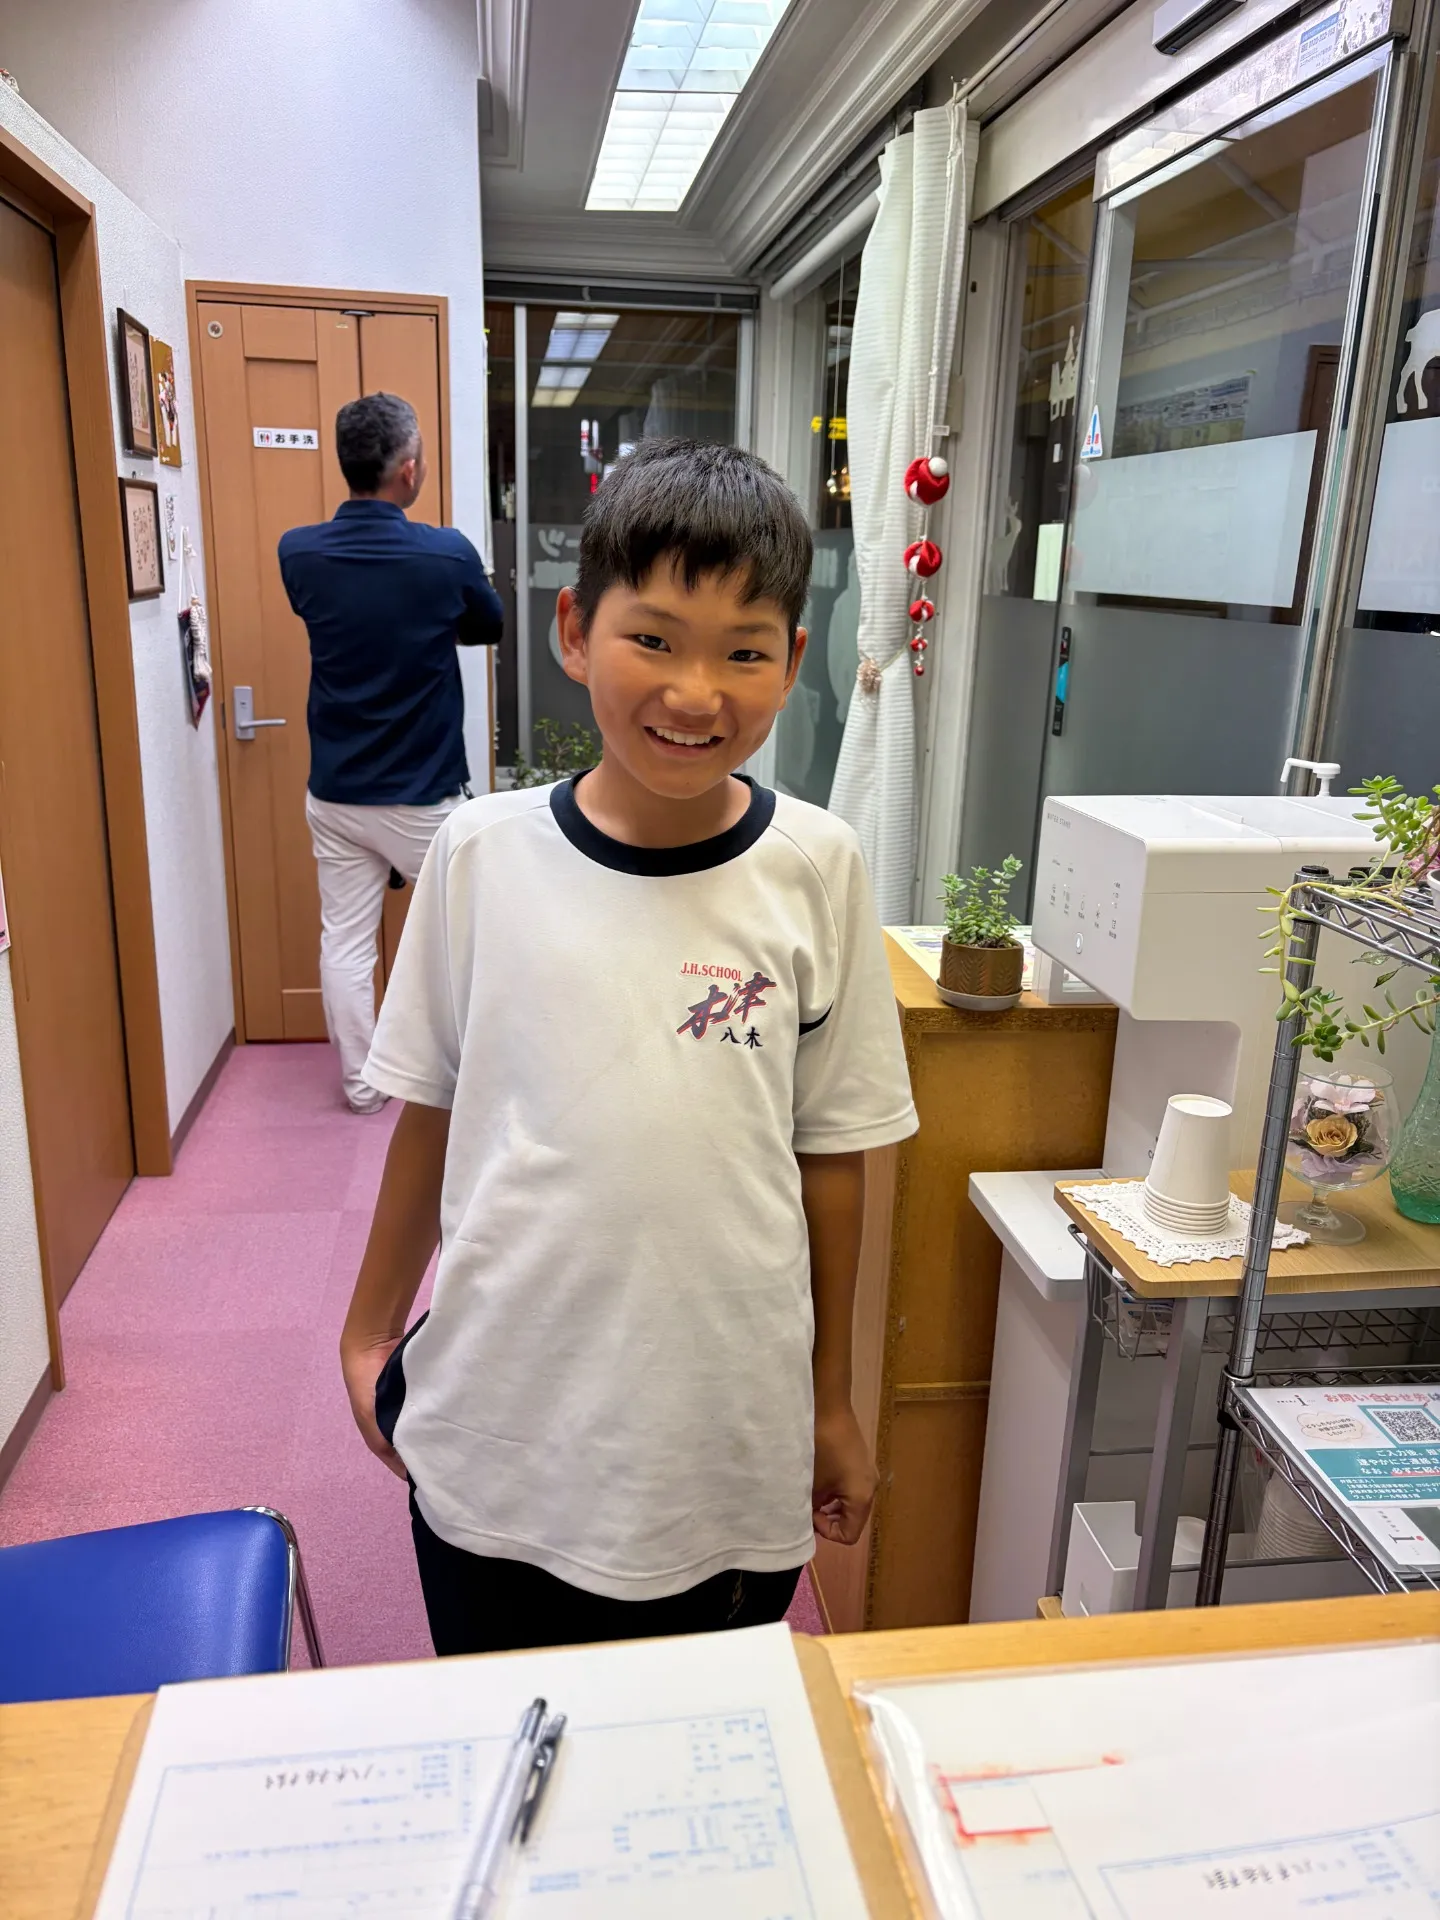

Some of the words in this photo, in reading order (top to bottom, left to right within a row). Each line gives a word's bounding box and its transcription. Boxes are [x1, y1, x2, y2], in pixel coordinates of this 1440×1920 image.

[275, 433, 314, 445] お手洗
[680, 962, 743, 982] J.H.SCHOOL
[720, 1026, 763, 1050] 八木
